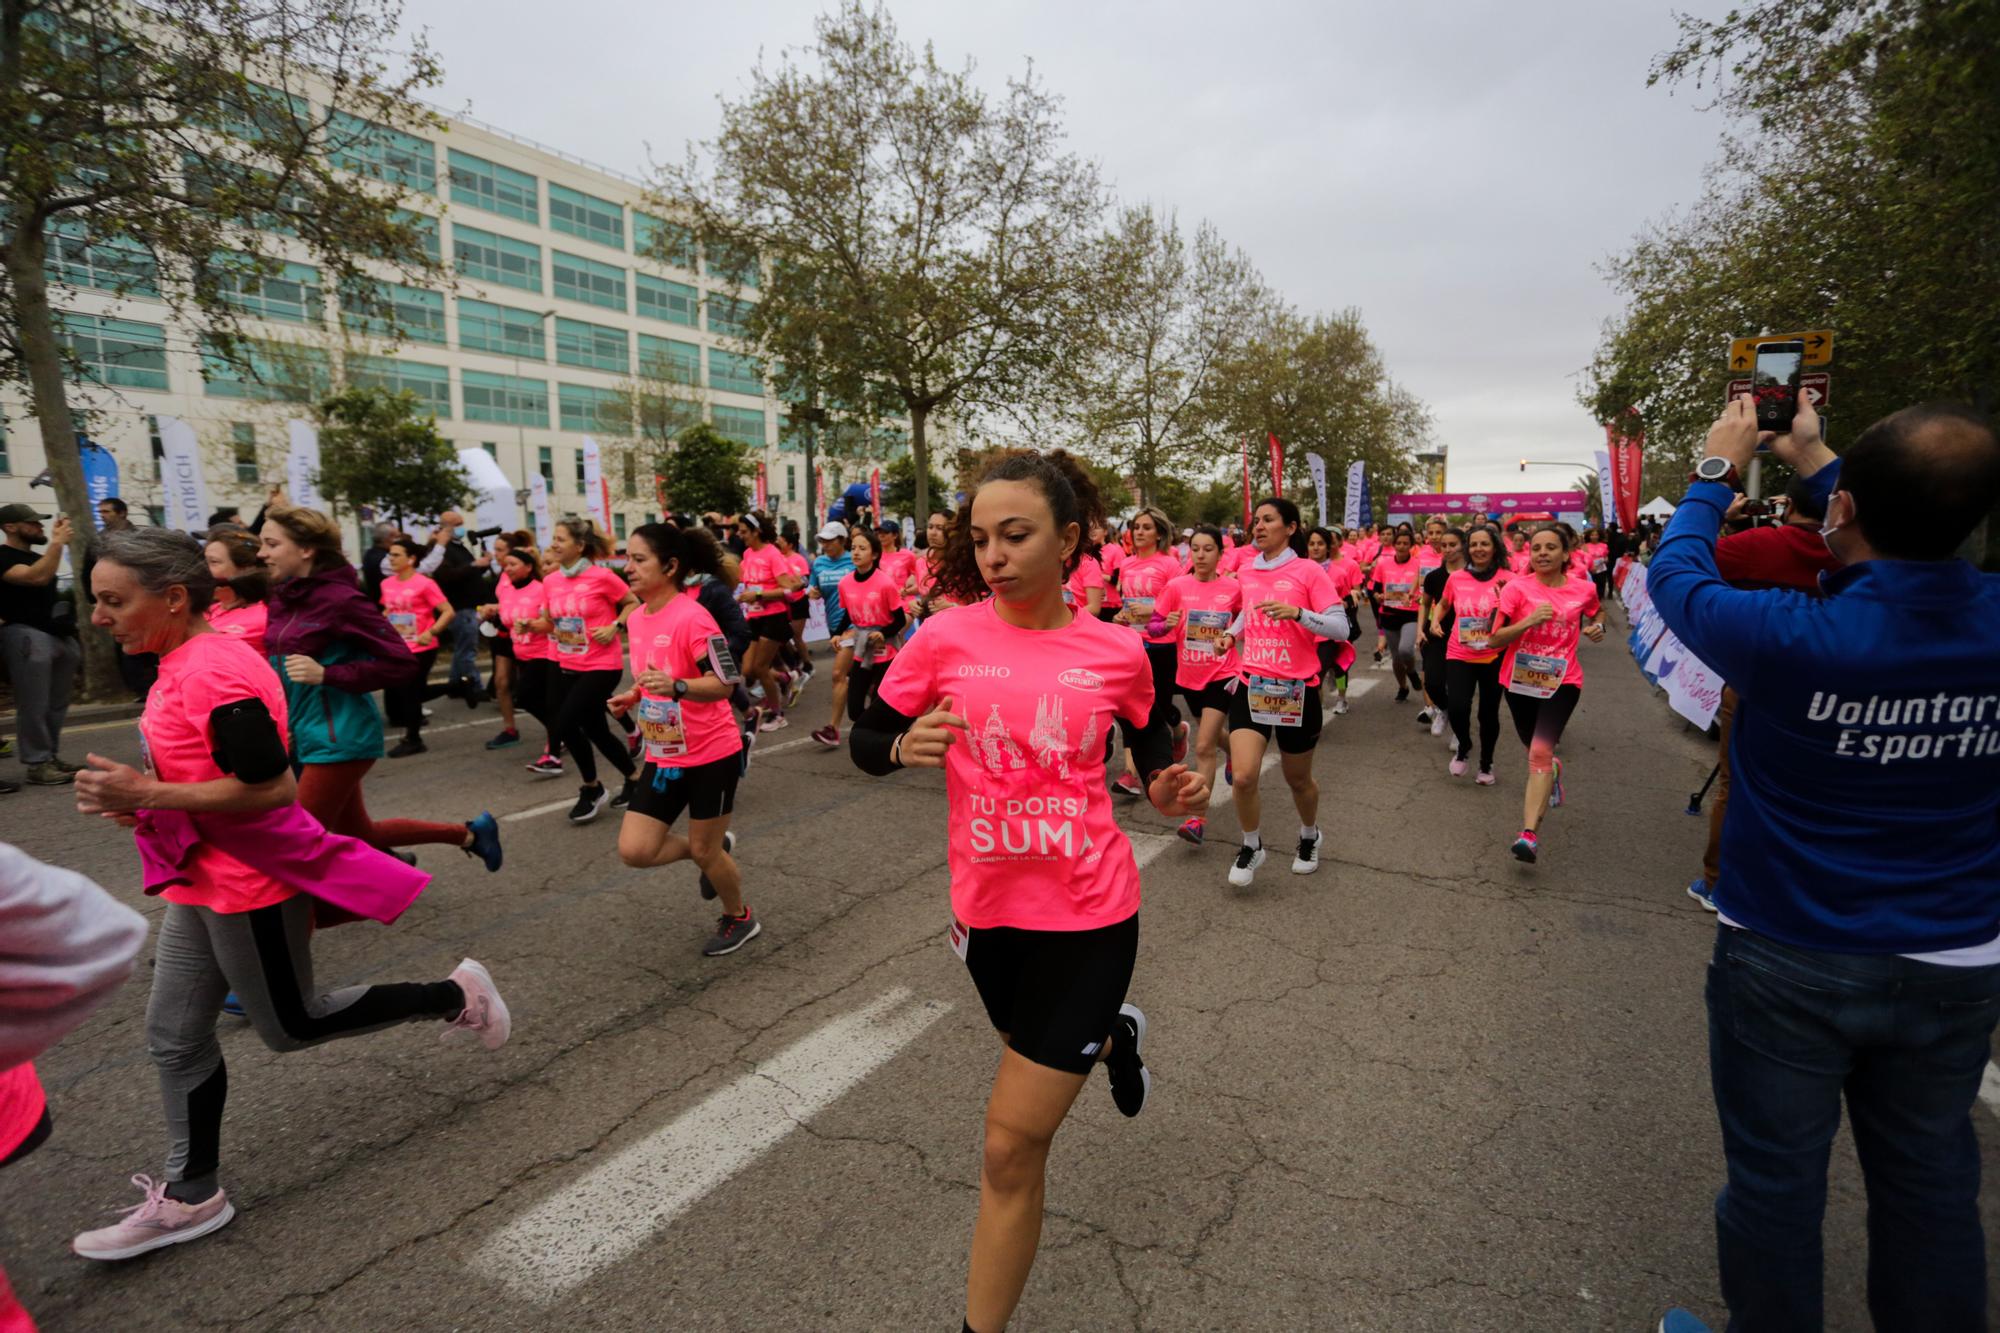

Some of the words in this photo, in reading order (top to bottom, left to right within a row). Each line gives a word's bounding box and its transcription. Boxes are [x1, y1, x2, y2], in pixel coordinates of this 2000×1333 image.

[1200, 626, 1219, 635] 016
[1244, 646, 1292, 664] SUMA
[958, 664, 1010, 678] OYSHO
[1527, 671, 1549, 680] 016
[1264, 696, 1287, 706] 016
[970, 794, 996, 815] TU
[1007, 796, 1088, 817] DORSA
